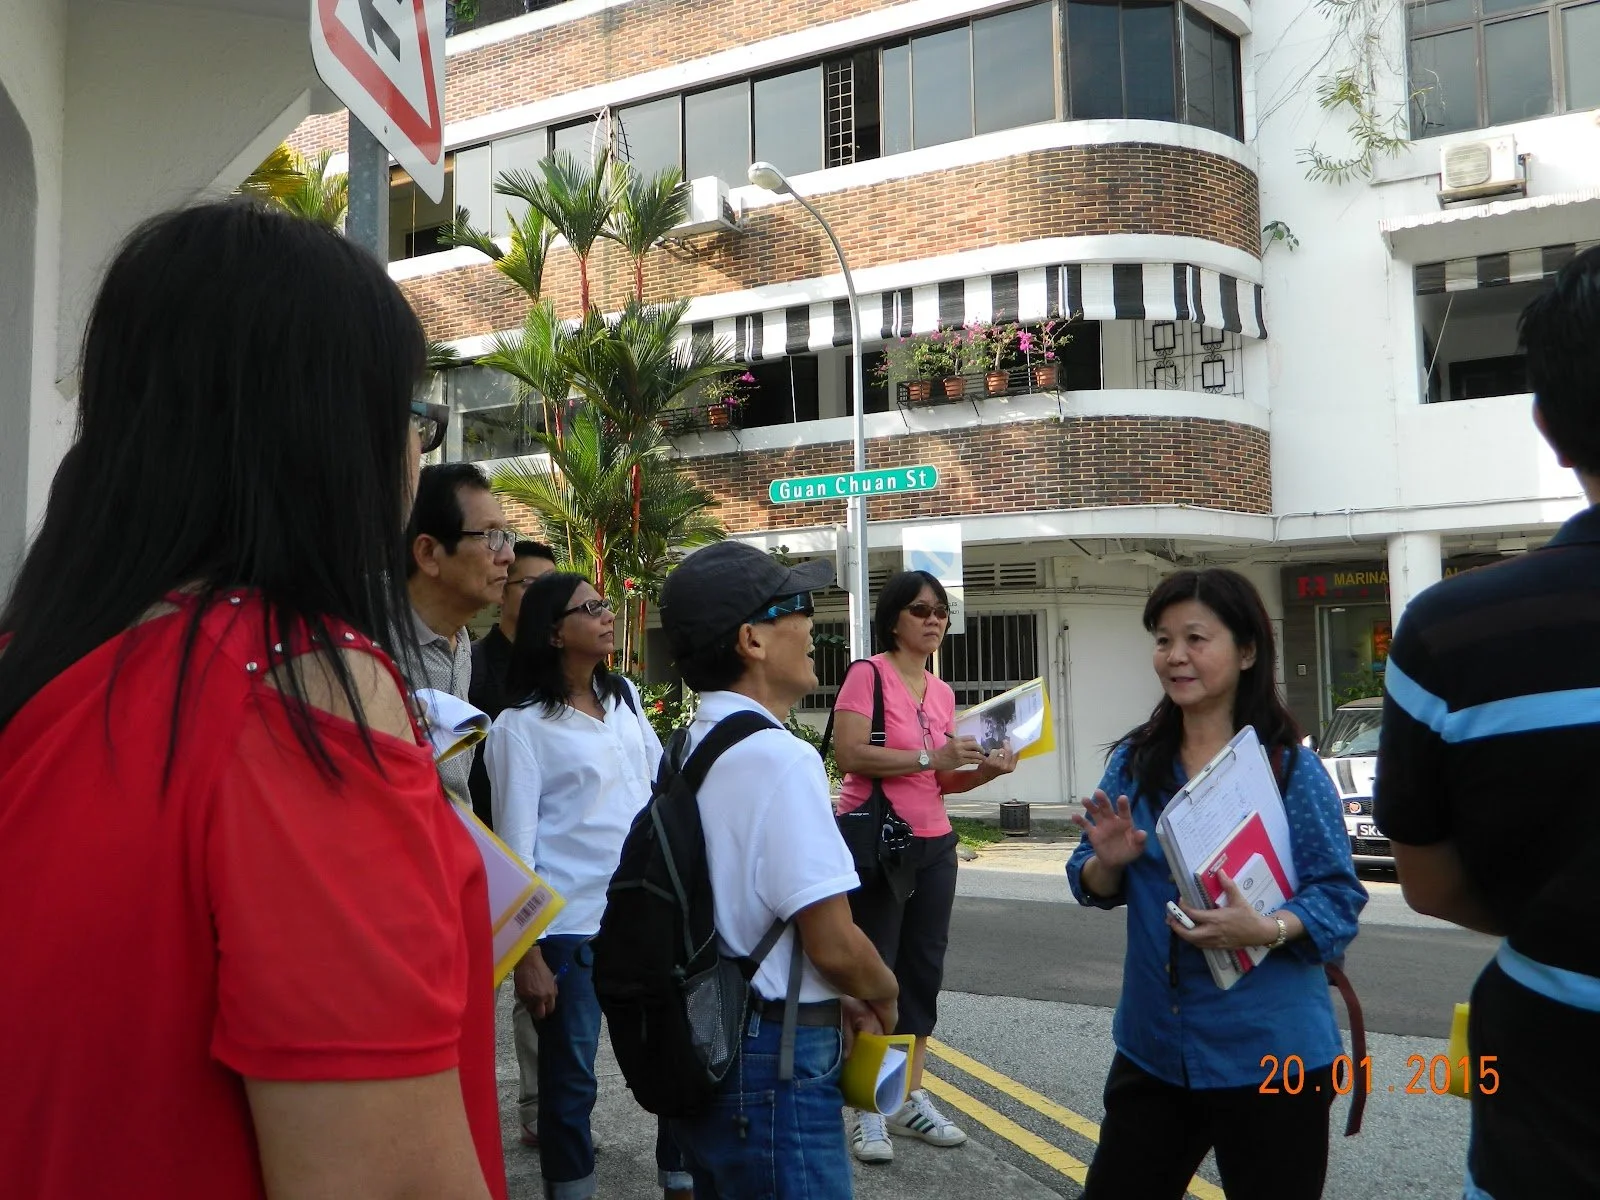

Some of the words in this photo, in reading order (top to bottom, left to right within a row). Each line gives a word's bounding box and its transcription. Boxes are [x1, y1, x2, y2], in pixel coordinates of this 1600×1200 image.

[779, 482, 826, 499] Guan
[835, 475, 897, 494] Chuan
[906, 469, 927, 488] St
[1334, 571, 1389, 586] MARINA
